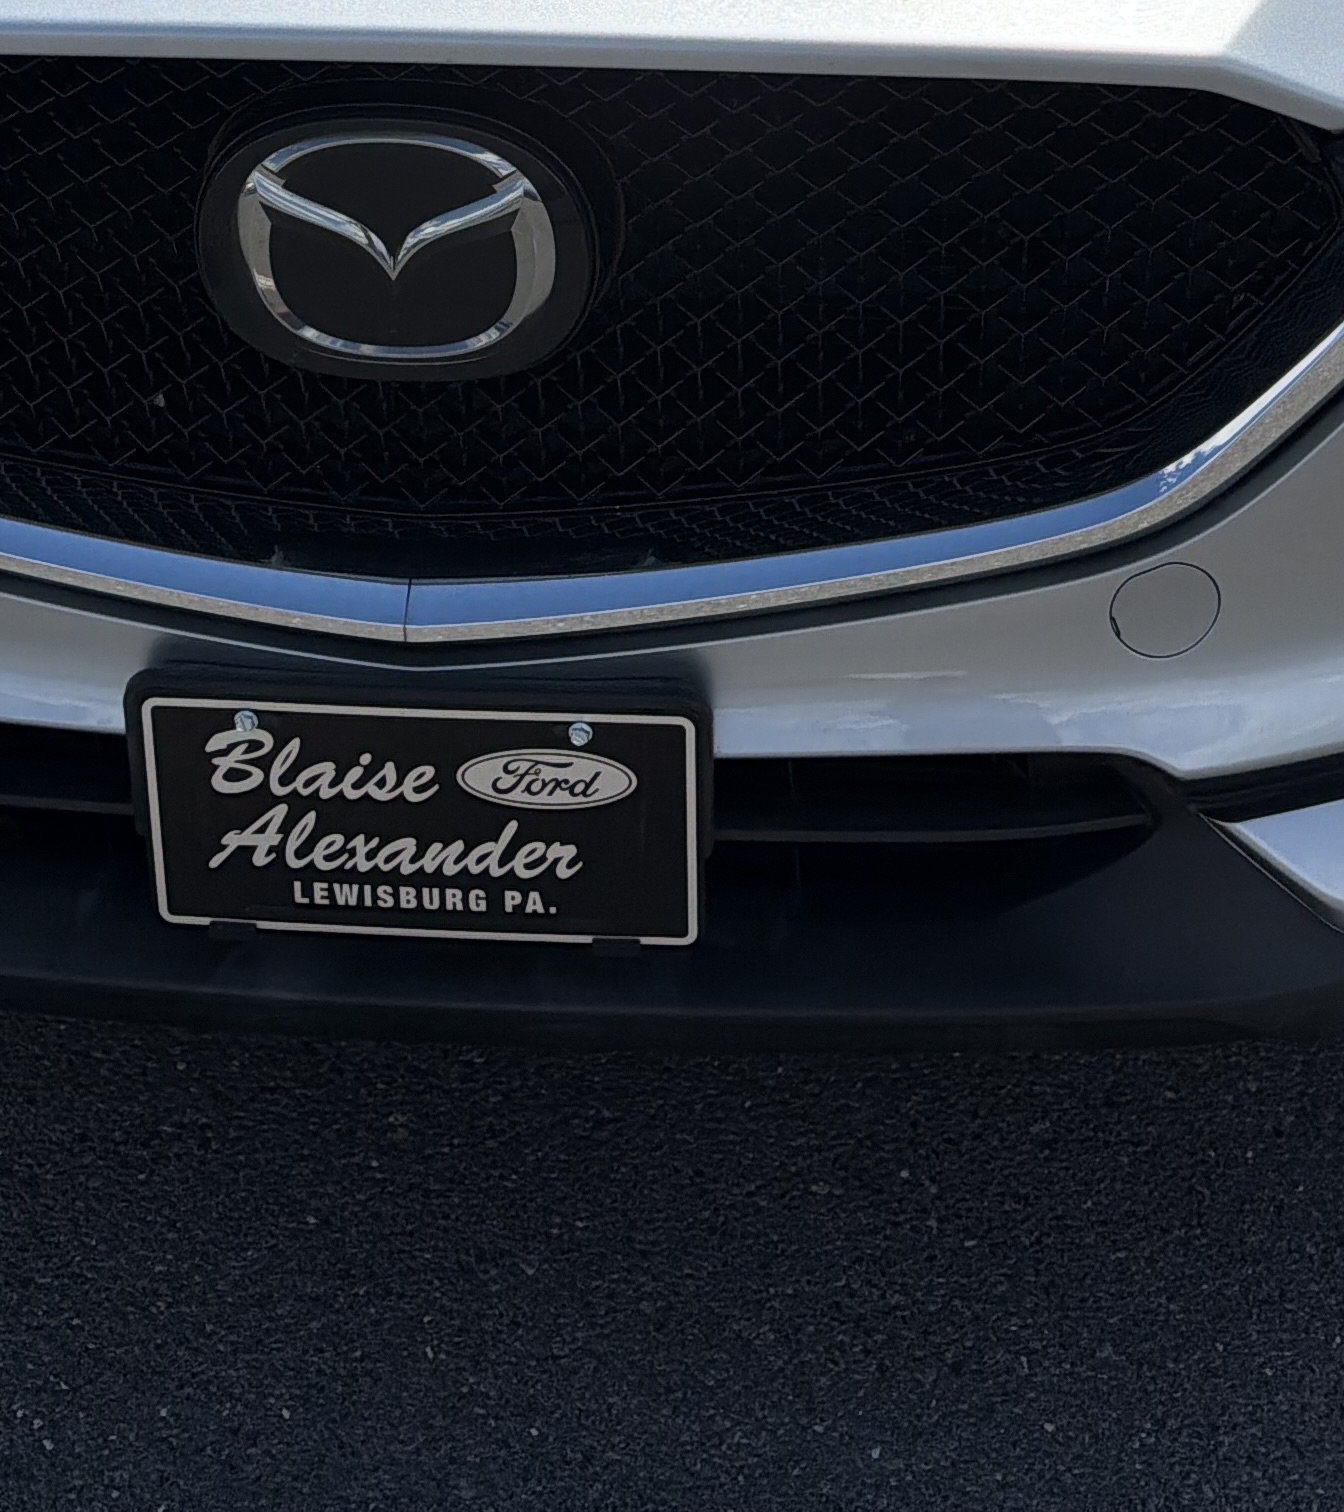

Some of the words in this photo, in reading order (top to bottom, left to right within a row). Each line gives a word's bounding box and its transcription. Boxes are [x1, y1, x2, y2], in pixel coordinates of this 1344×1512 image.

[205, 729, 439, 803] Blaise
[491, 758, 602, 798] Ford
[209, 803, 583, 880] Alexander
[293, 881, 488, 912] LEWISBURG
[504, 891, 558, 915] PA.
